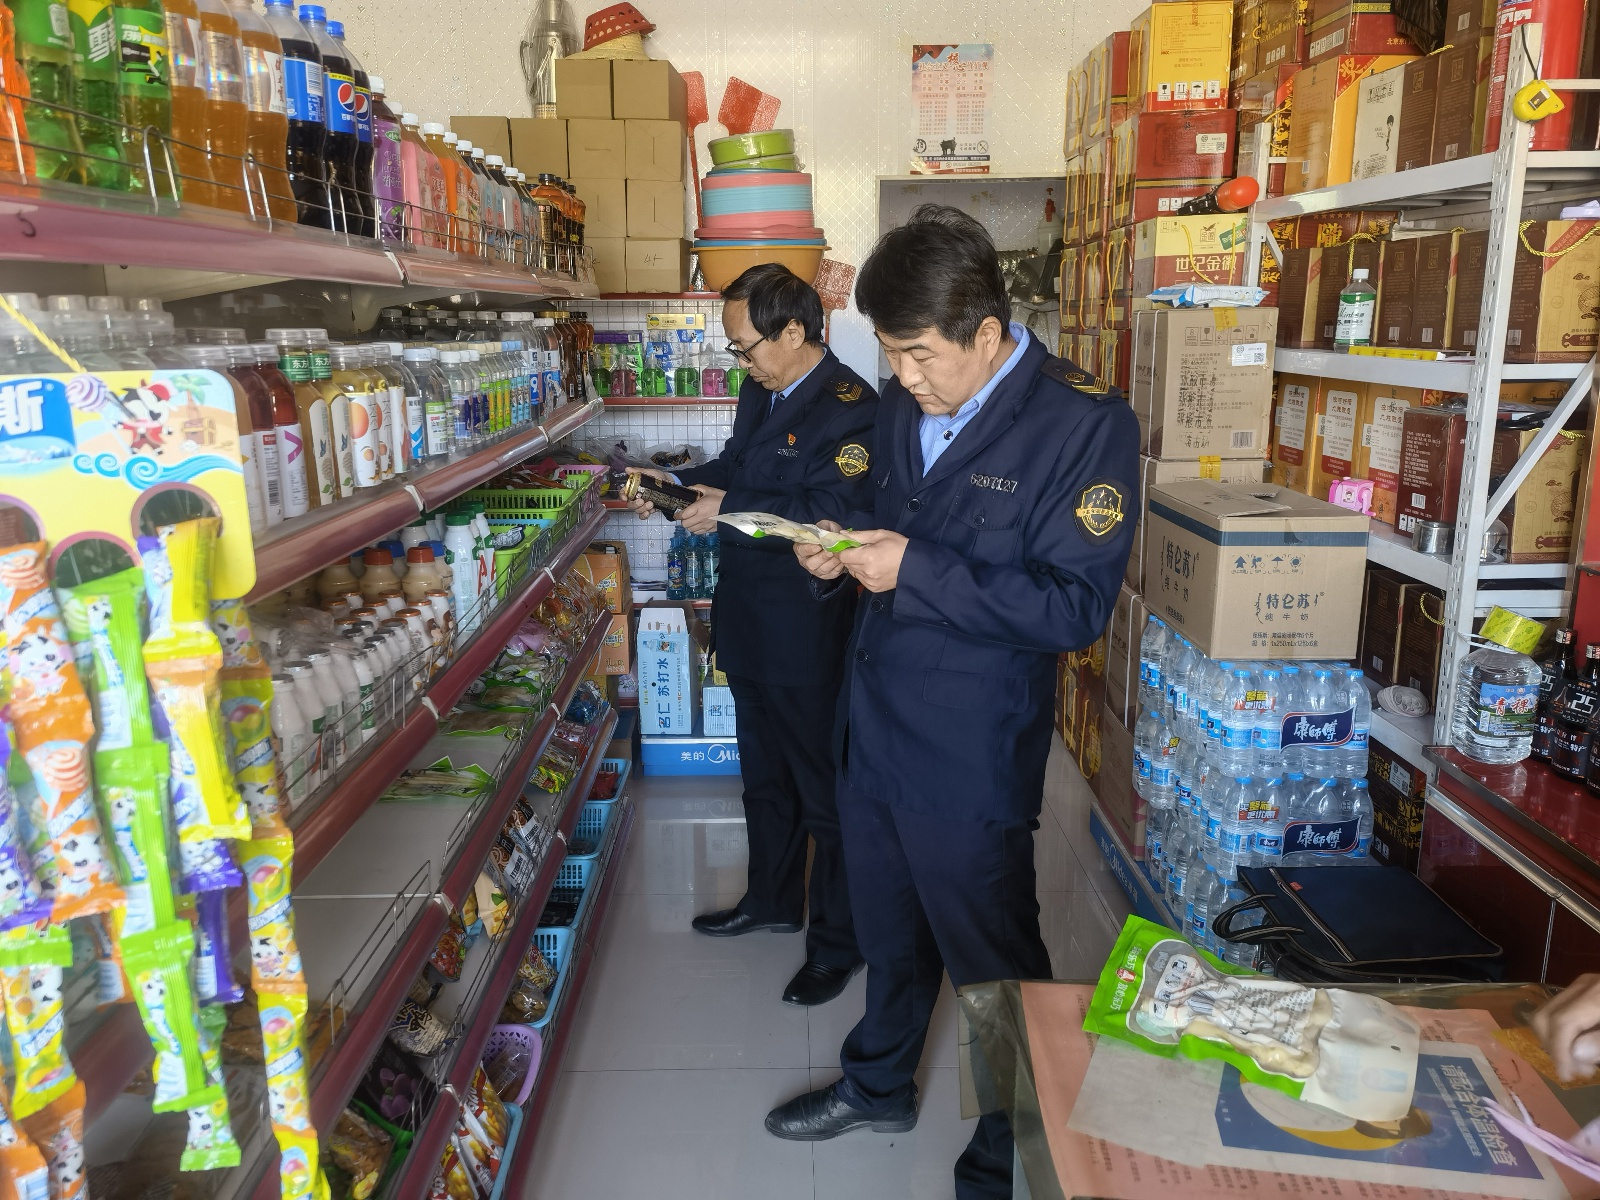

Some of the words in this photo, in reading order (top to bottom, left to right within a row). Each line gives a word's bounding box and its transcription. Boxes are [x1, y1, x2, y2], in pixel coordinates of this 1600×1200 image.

[1175, 254, 1237, 273] 世纪金徽
[1166, 540, 1191, 579] 特仑苏
[1266, 593, 1310, 610] 特仑苏
[1264, 612, 1309, 622] 纯牛奶
[680, 751, 706, 762] 美的
[1440, 1063, 1518, 1167] 请配合体温检查
